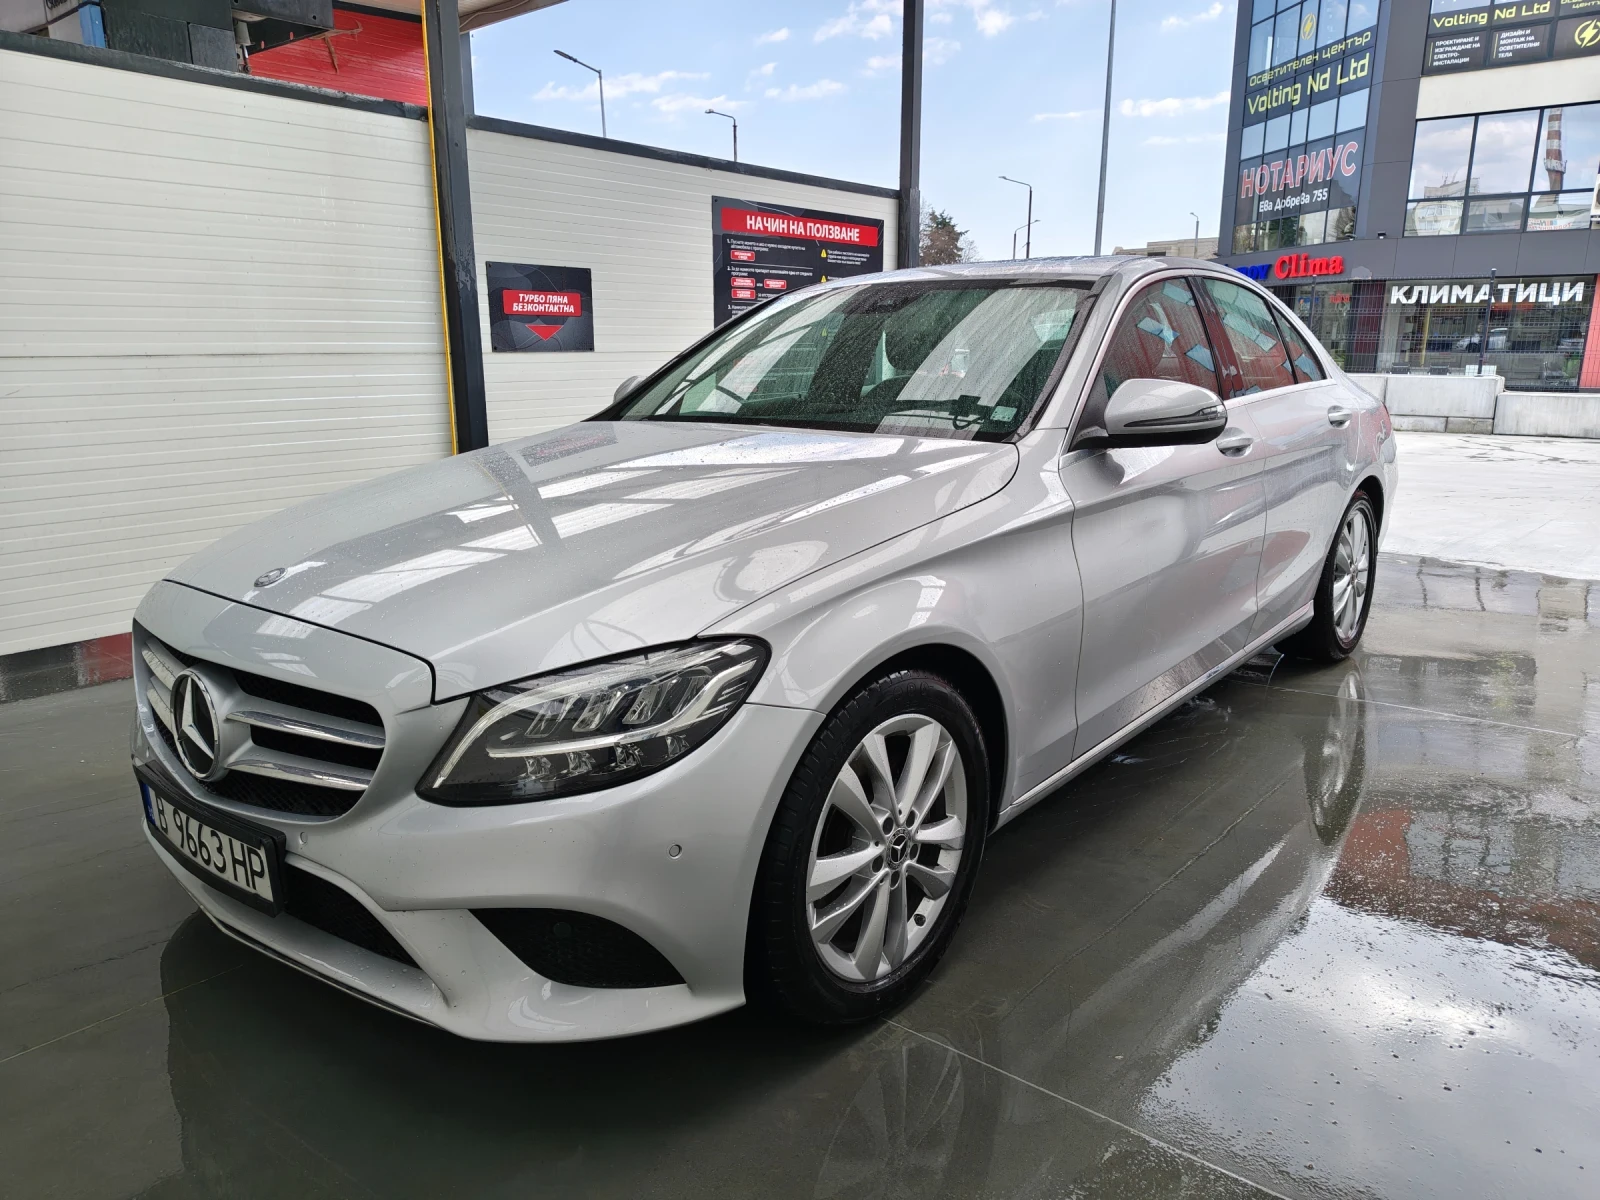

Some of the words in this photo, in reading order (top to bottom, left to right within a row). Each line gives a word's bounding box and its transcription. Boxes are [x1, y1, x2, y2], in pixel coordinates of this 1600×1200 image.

[1433, 12, 1488, 28] Volting
[1494, 6, 1516, 20] Nd
[1521, 1, 1550, 16] Ltd
[1435, 37, 1474, 47] ПРОЕКТИРАНЕ
[1498, 41, 1540, 51] ОСВЕТИТЕЛНИ
[1499, 37, 1525, 45] МОНТАЖ
[1500, 30, 1525, 39] ДИЗАЙН
[1249, 52, 1319, 87] Осветителен
[1322, 31, 1371, 59] център
[1434, 43, 1473, 53] ИЗГРАЖДАНЕ
[1247, 82, 1302, 115] Volting
[1306, 67, 1331, 96] Nd
[1336, 52, 1370, 86] Ltd
[1241, 141, 1359, 199] НОТАРИУС
[1258, 200, 1273, 213] Ева
[1274, 192, 1310, 212] Добрева
[1311, 187, 1329, 203] 755
[746, 214, 788, 233] НАЧИН
[789, 220, 805, 236] НА
[806, 222, 860, 242] ПОЛЗВАНЕ
[1274, 253, 1345, 280] Clima
[518, 293, 545, 303] ТУРБО
[546, 294, 569, 304] ПЯНА
[1390, 281, 1585, 306] КЛИМАТИЦИ
[512, 302, 575, 313] БЕЗКОНТАКТНА
